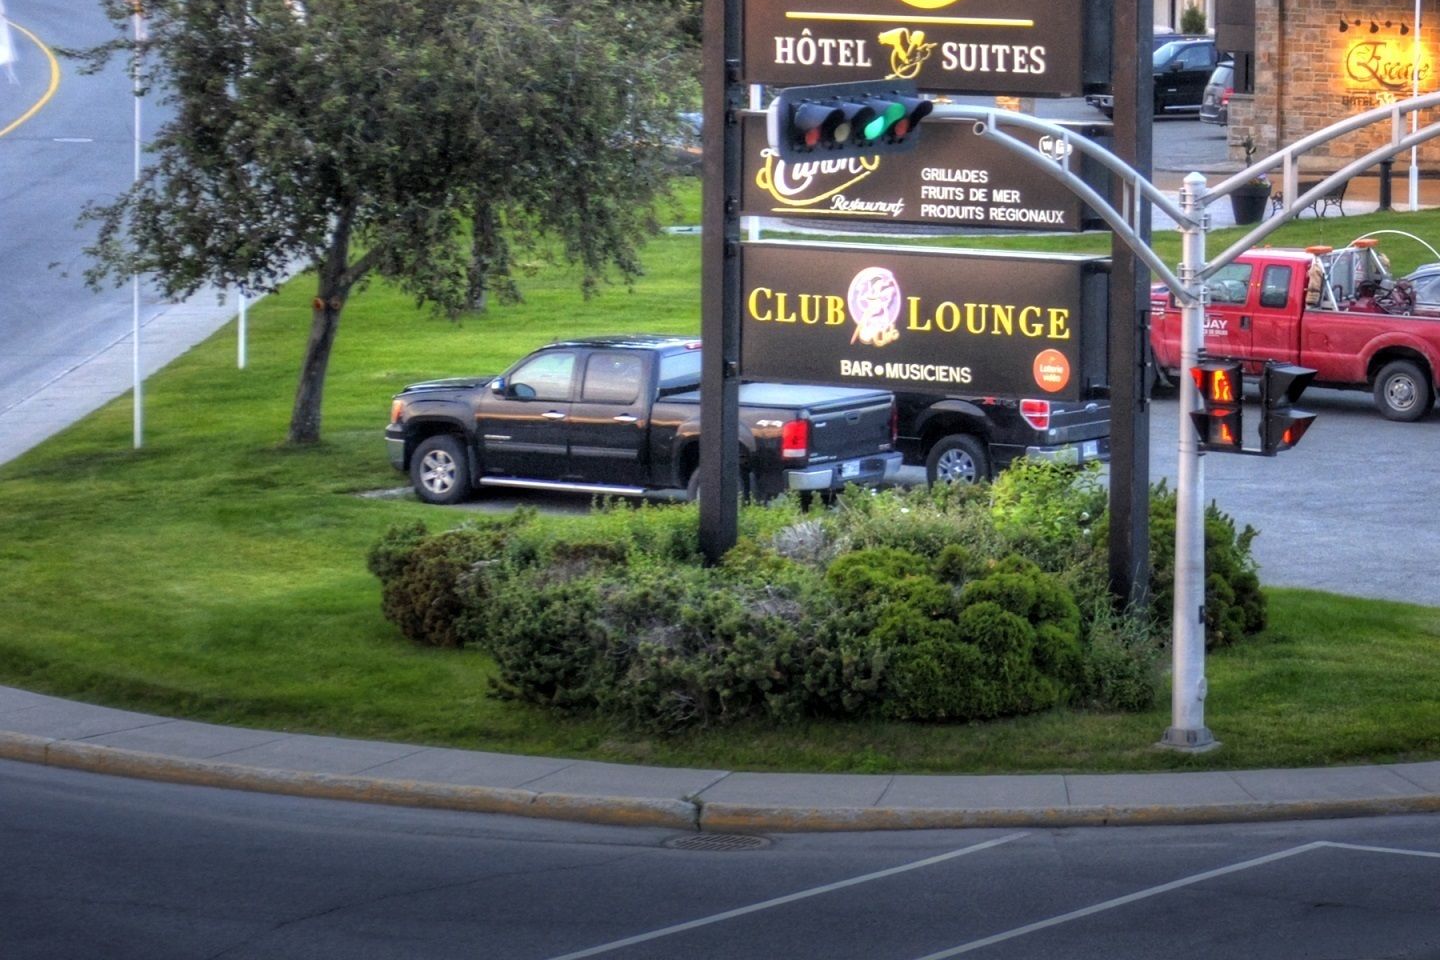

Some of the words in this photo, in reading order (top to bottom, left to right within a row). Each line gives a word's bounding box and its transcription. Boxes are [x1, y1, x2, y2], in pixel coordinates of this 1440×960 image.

[773, 28, 872, 67] HÔTEL
[941, 41, 1046, 75] SUITES
[920, 167, 988, 183] GRILLADES
[829, 194, 905, 217] Restaurant
[920, 186, 965, 201] FRUITS
[969, 188, 988, 202] DE
[992, 189, 1021, 203] MER
[920, 204, 985, 220] PRODUITS
[989, 206, 1065, 224] RÉGIONAUX
[748, 287, 846, 325] CLUB
[906, 296, 1071, 339] LOUNGE
[840, 359, 874, 377] BAR
[885, 362, 972, 384] MUSICIENS
